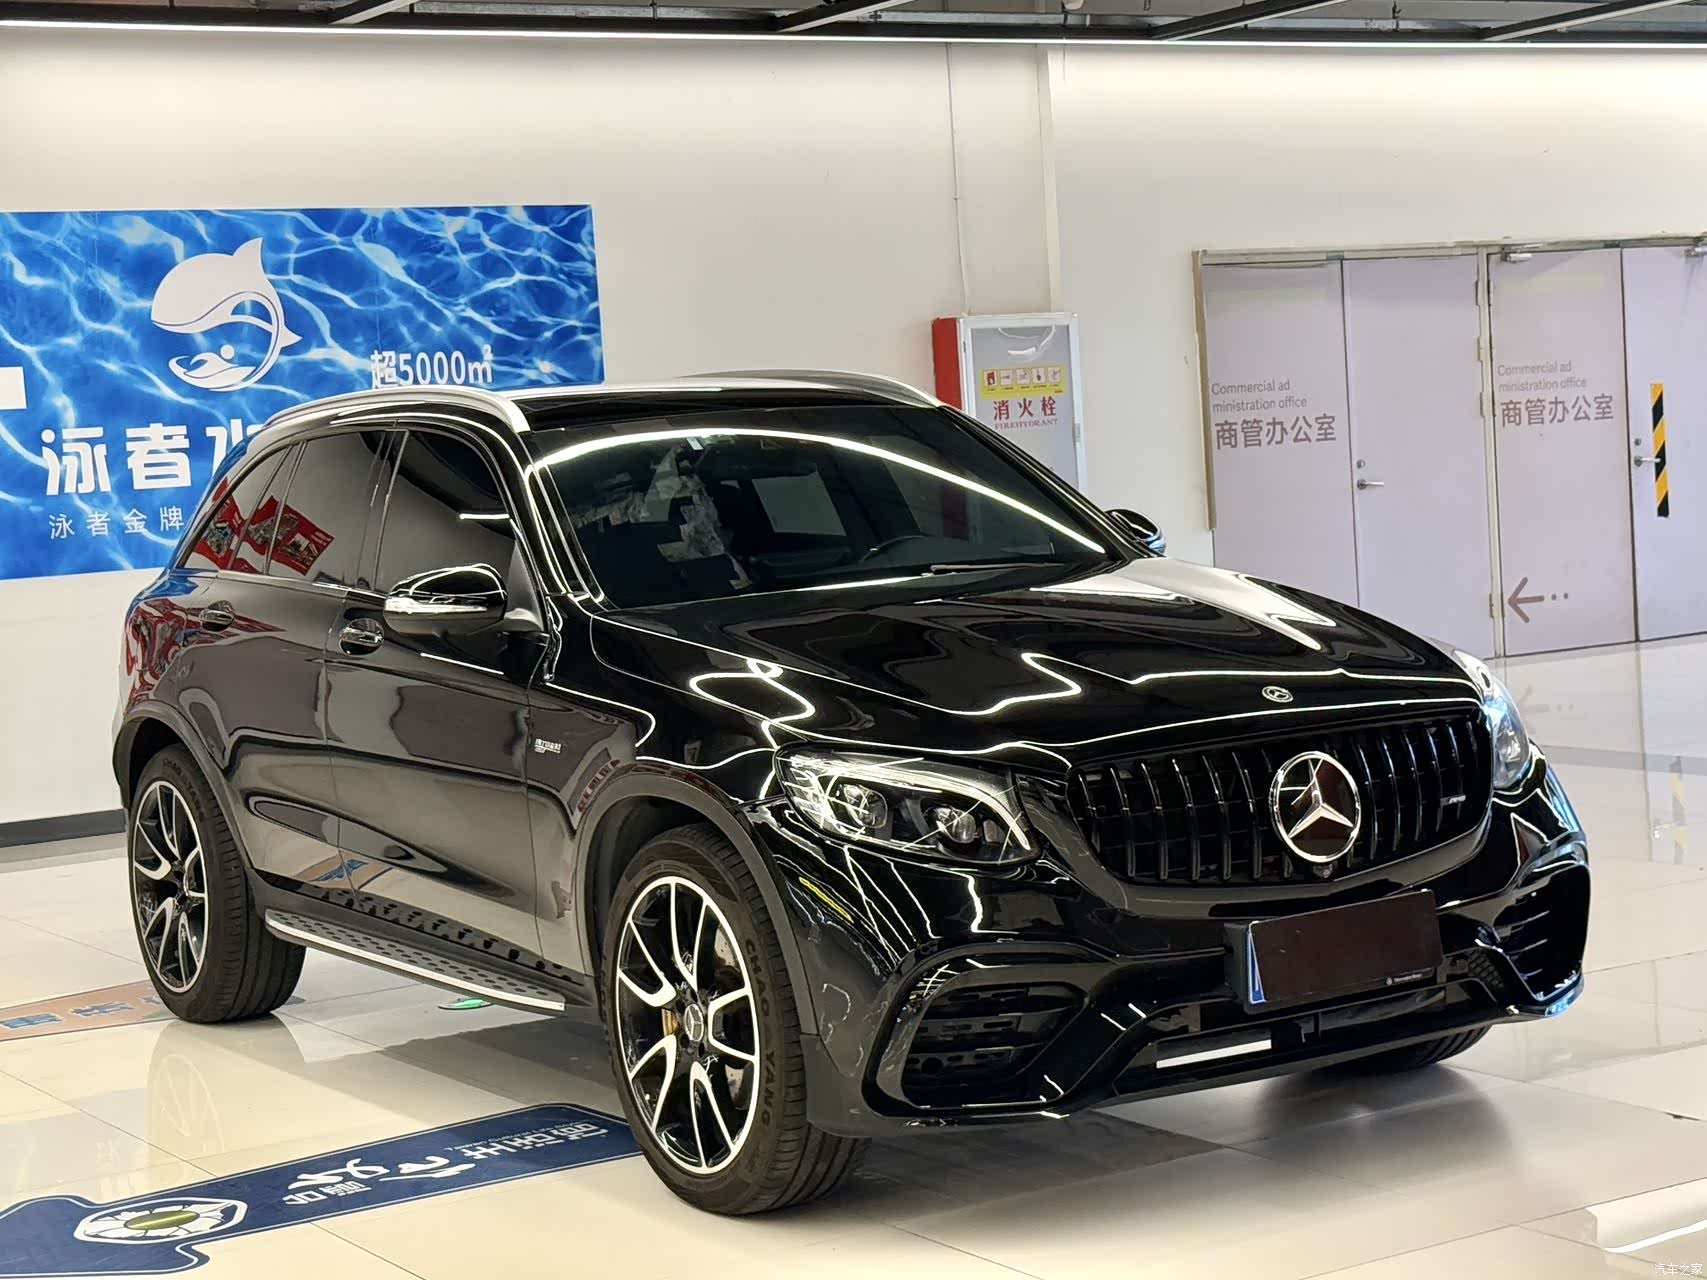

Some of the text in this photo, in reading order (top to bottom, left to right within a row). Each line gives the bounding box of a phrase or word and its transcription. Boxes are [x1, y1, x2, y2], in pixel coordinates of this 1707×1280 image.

[1497, 360, 1572, 376] Commercial ad
[1211, 380, 1290, 395] Commercial ad
[1498, 376, 1587, 392] ministration office
[993, 396, 1057, 420] 消火栓
[1212, 396, 1307, 413] ministration office
[1500, 393, 1614, 427] 商管办公室
[1214, 413, 1336, 450] 商管办公室
[49, 505, 185, 540] 泳者金牌
